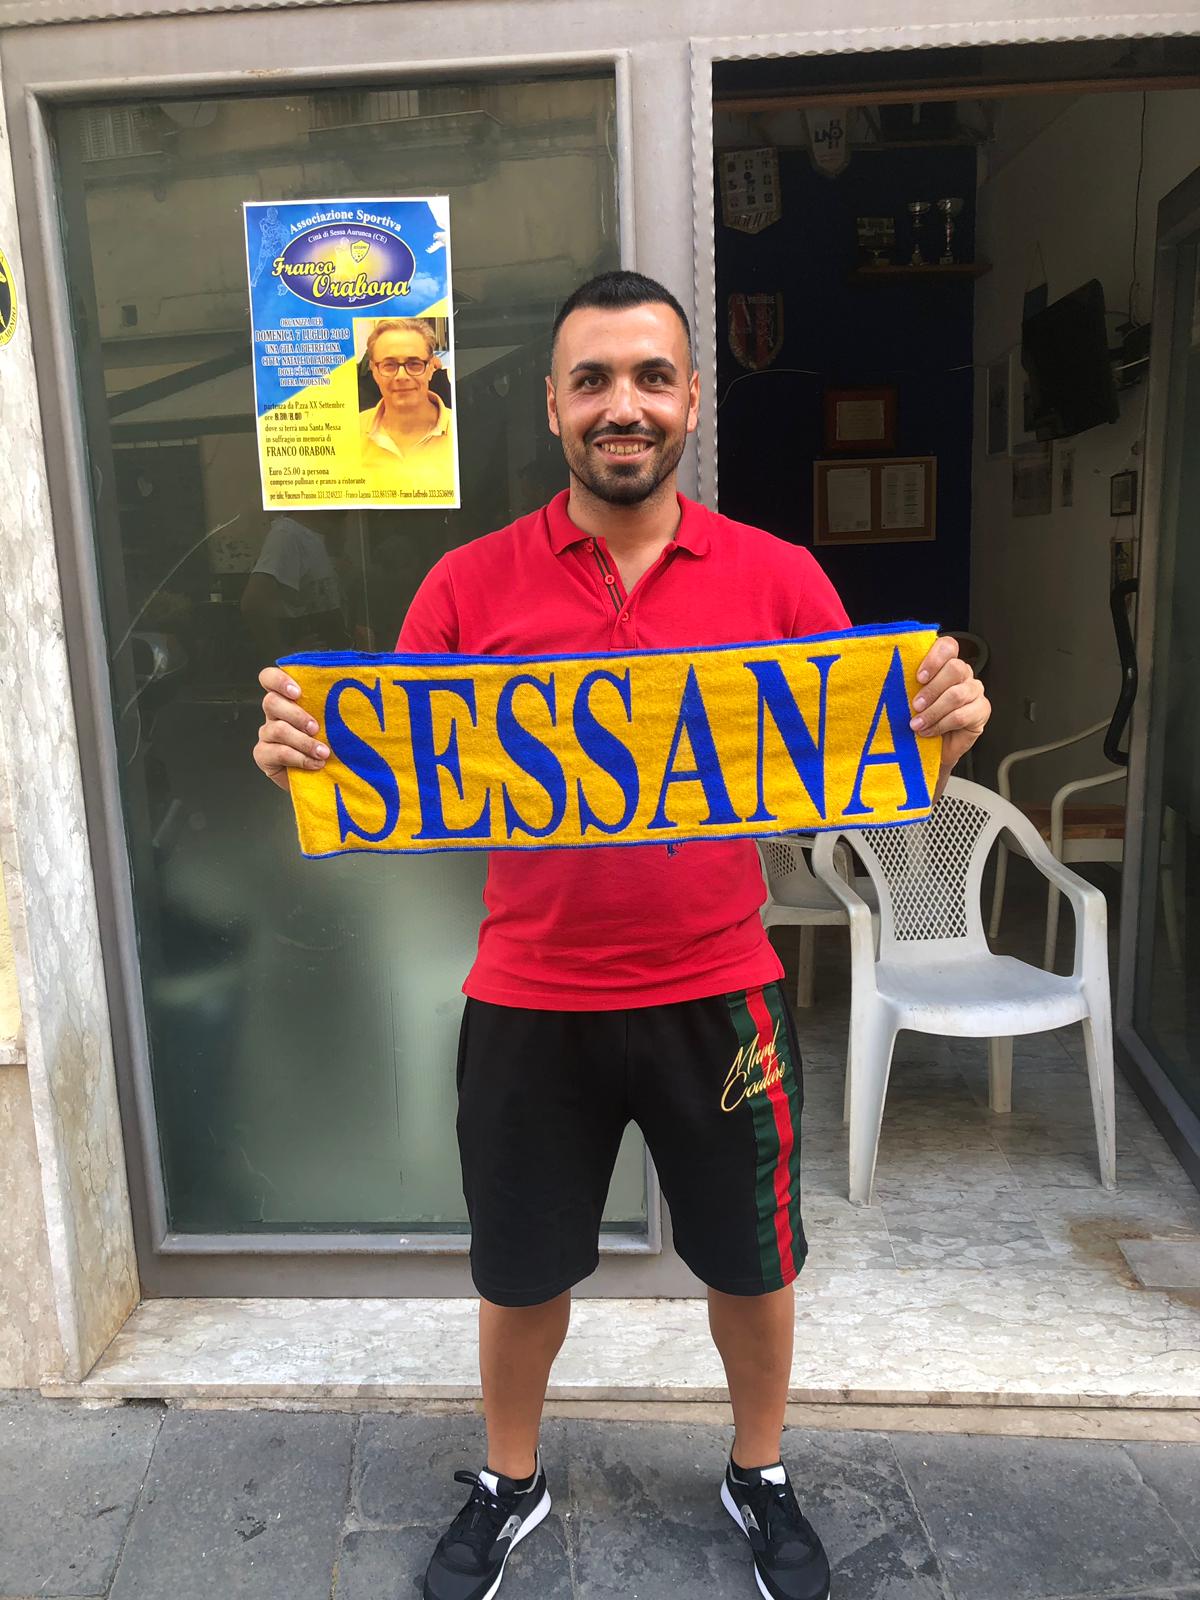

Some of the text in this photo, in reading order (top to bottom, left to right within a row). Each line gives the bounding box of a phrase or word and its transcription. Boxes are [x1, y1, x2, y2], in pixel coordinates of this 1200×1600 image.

[290, 209, 402, 234] Associazione Sportiva
[329, 229, 346, 237] Sessa
[346, 228, 372, 238] Aurunca
[372, 232, 388, 244] (CE)
[271, 256, 335, 277] Franco
[311, 272, 411, 298] Orabona
[255, 328, 350, 342] DOMENICA 7 LUGLIO 2019
[294, 343, 300, 353] A
[282, 356, 304, 366] NATALE
[313, 355, 334, 365] PADRE
[334, 354, 346, 364] PIO
[298, 377, 331, 386] MODESTINO
[263, 402, 286, 411] partenza
[287, 401, 294, 409] da
[309, 401, 318, 409] XX
[318, 400, 345, 409] Settembre
[265, 424, 278, 432] dove
[309, 423, 324, 431] Santa
[324, 422, 341, 432] Messa
[266, 435, 271, 443] in
[272, 434, 295, 444] suffragio
[302, 435, 325, 443] memoria
[326, 434, 332, 442] di
[266, 445, 336, 457] FRANCO ORABONA
[269, 467, 282, 476] Euro
[283, 467, 300, 476] 25.00
[307, 468, 329, 476] persona
[400, 489, 412, 498] Franco
[322, 644, 932, 845] SESSANA
